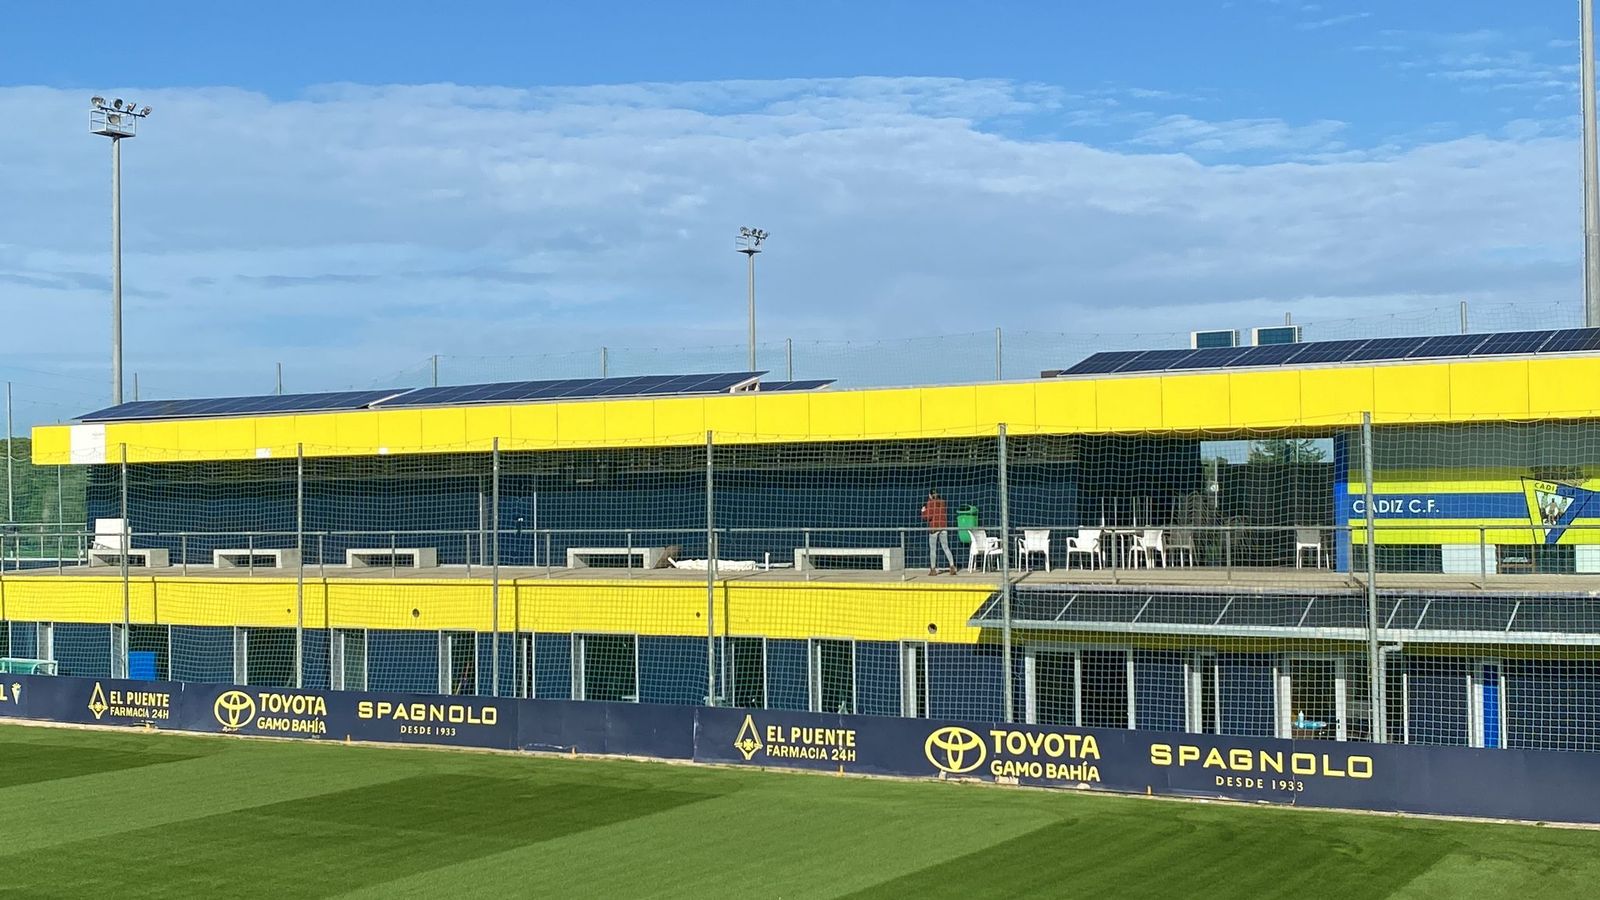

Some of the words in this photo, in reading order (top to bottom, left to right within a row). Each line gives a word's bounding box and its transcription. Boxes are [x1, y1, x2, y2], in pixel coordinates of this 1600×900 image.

[1409, 499, 1440, 513] C.F.
[110, 691, 123, 704] EL
[127, 691, 170, 707] PUENTE
[259, 693, 327, 716] TOYOTA
[110, 706, 150, 718] FARMACIA
[151, 709, 169, 719] 24H
[358, 701, 497, 725] SPAGNOLO
[257, 716, 290, 731] GAMO
[292, 717, 326, 734] BAHÍA
[400, 725, 432, 735] DESDE
[436, 727, 456, 736] 1933
[766, 725, 786, 743] EL
[791, 726, 856, 747] PUENTE
[990, 730, 1100, 760] TOYOTA
[766, 744, 828, 760] FARMACIA
[831, 748, 856, 762] 24H
[1150, 743, 1374, 779] SPAGNOLO
[990, 760, 1043, 777] GAMO
[1045, 761, 1101, 782] BAHÍA
[1215, 775, 1264, 789] DESDE
[1272, 779, 1304, 792] 1933
